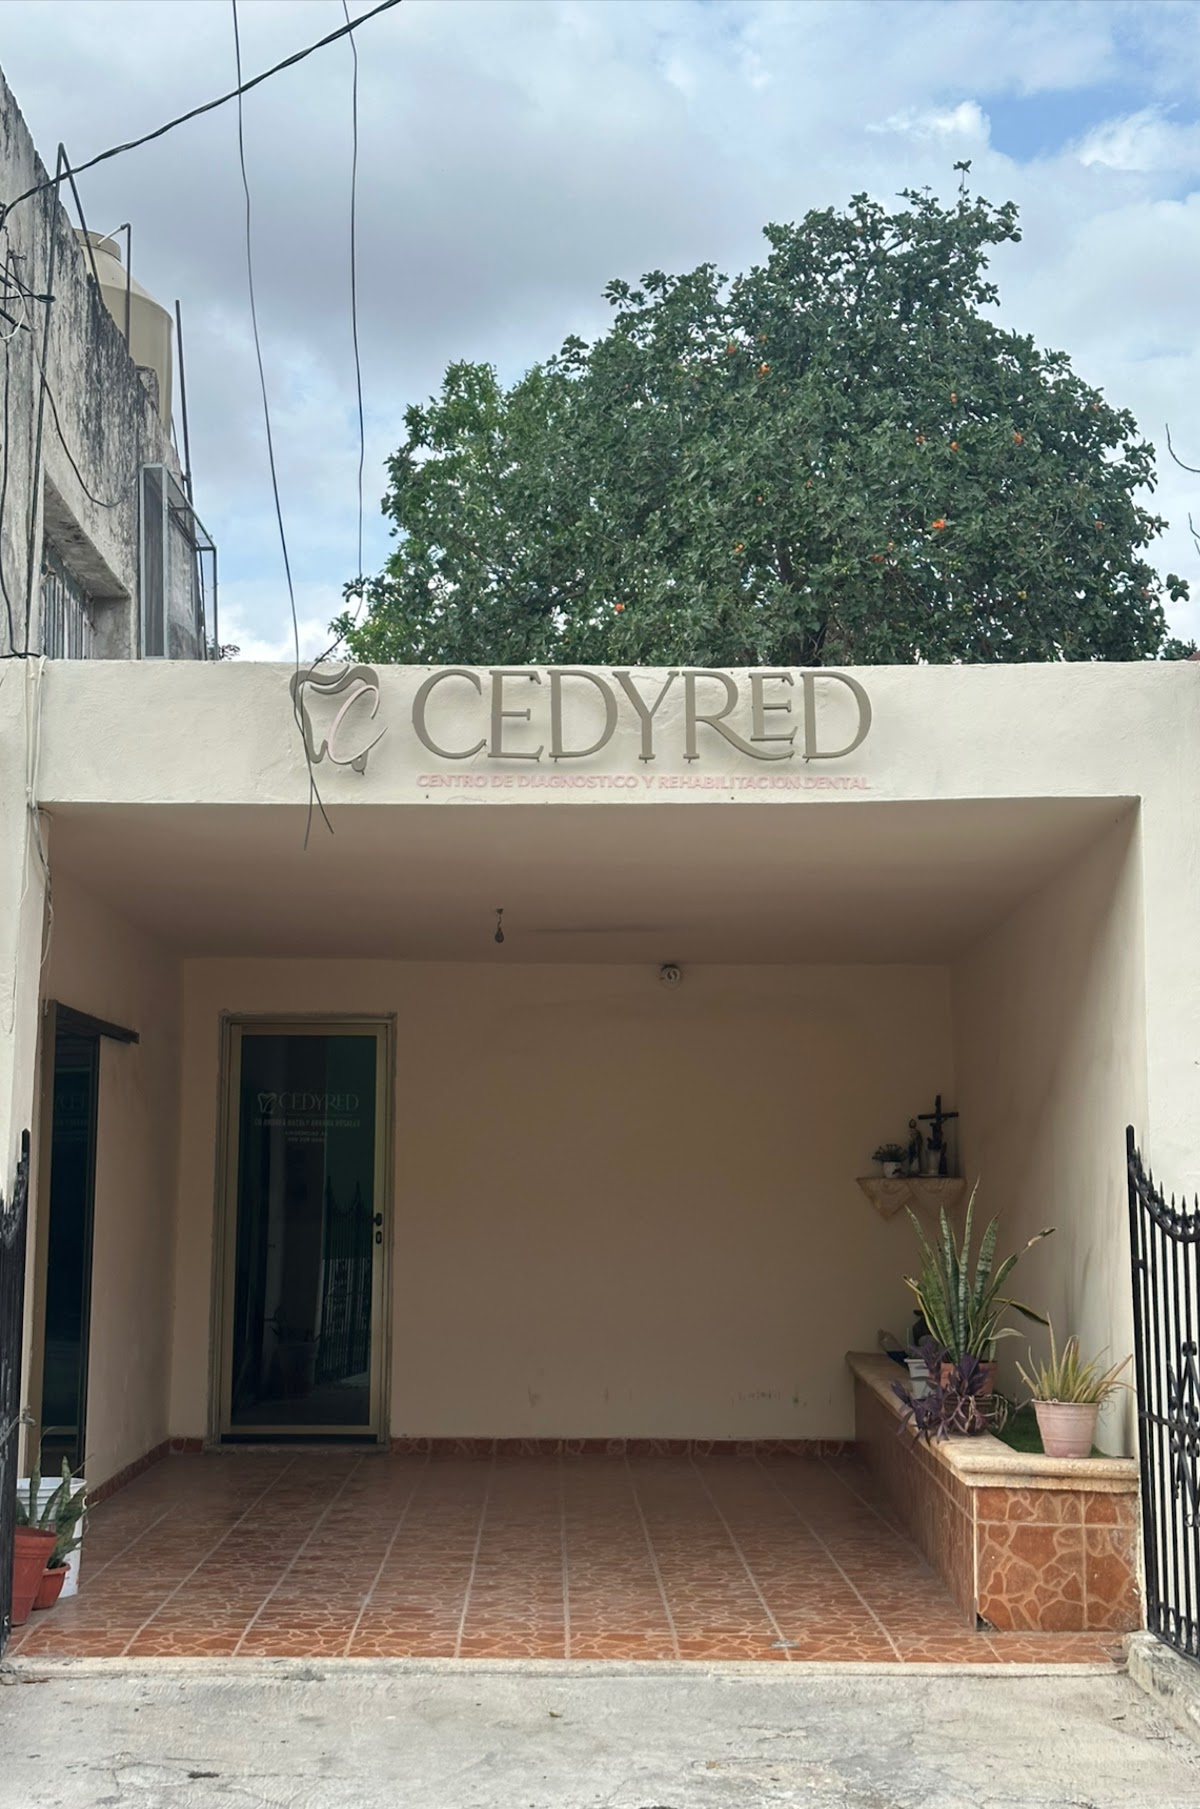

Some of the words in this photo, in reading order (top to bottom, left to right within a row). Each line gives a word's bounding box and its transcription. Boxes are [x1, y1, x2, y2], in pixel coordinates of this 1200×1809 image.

[412, 669, 872, 761] CEDYRED
[417, 774, 488, 788] CENTRO
[491, 774, 513, 788] DE
[517, 774, 639, 788] DIAGNOSTICO
[642, 775, 655, 788] Y
[658, 775, 801, 790] REHABILITACION
[803, 776, 872, 790] DENTAL
[279, 1092, 360, 1111] CEDYRED
